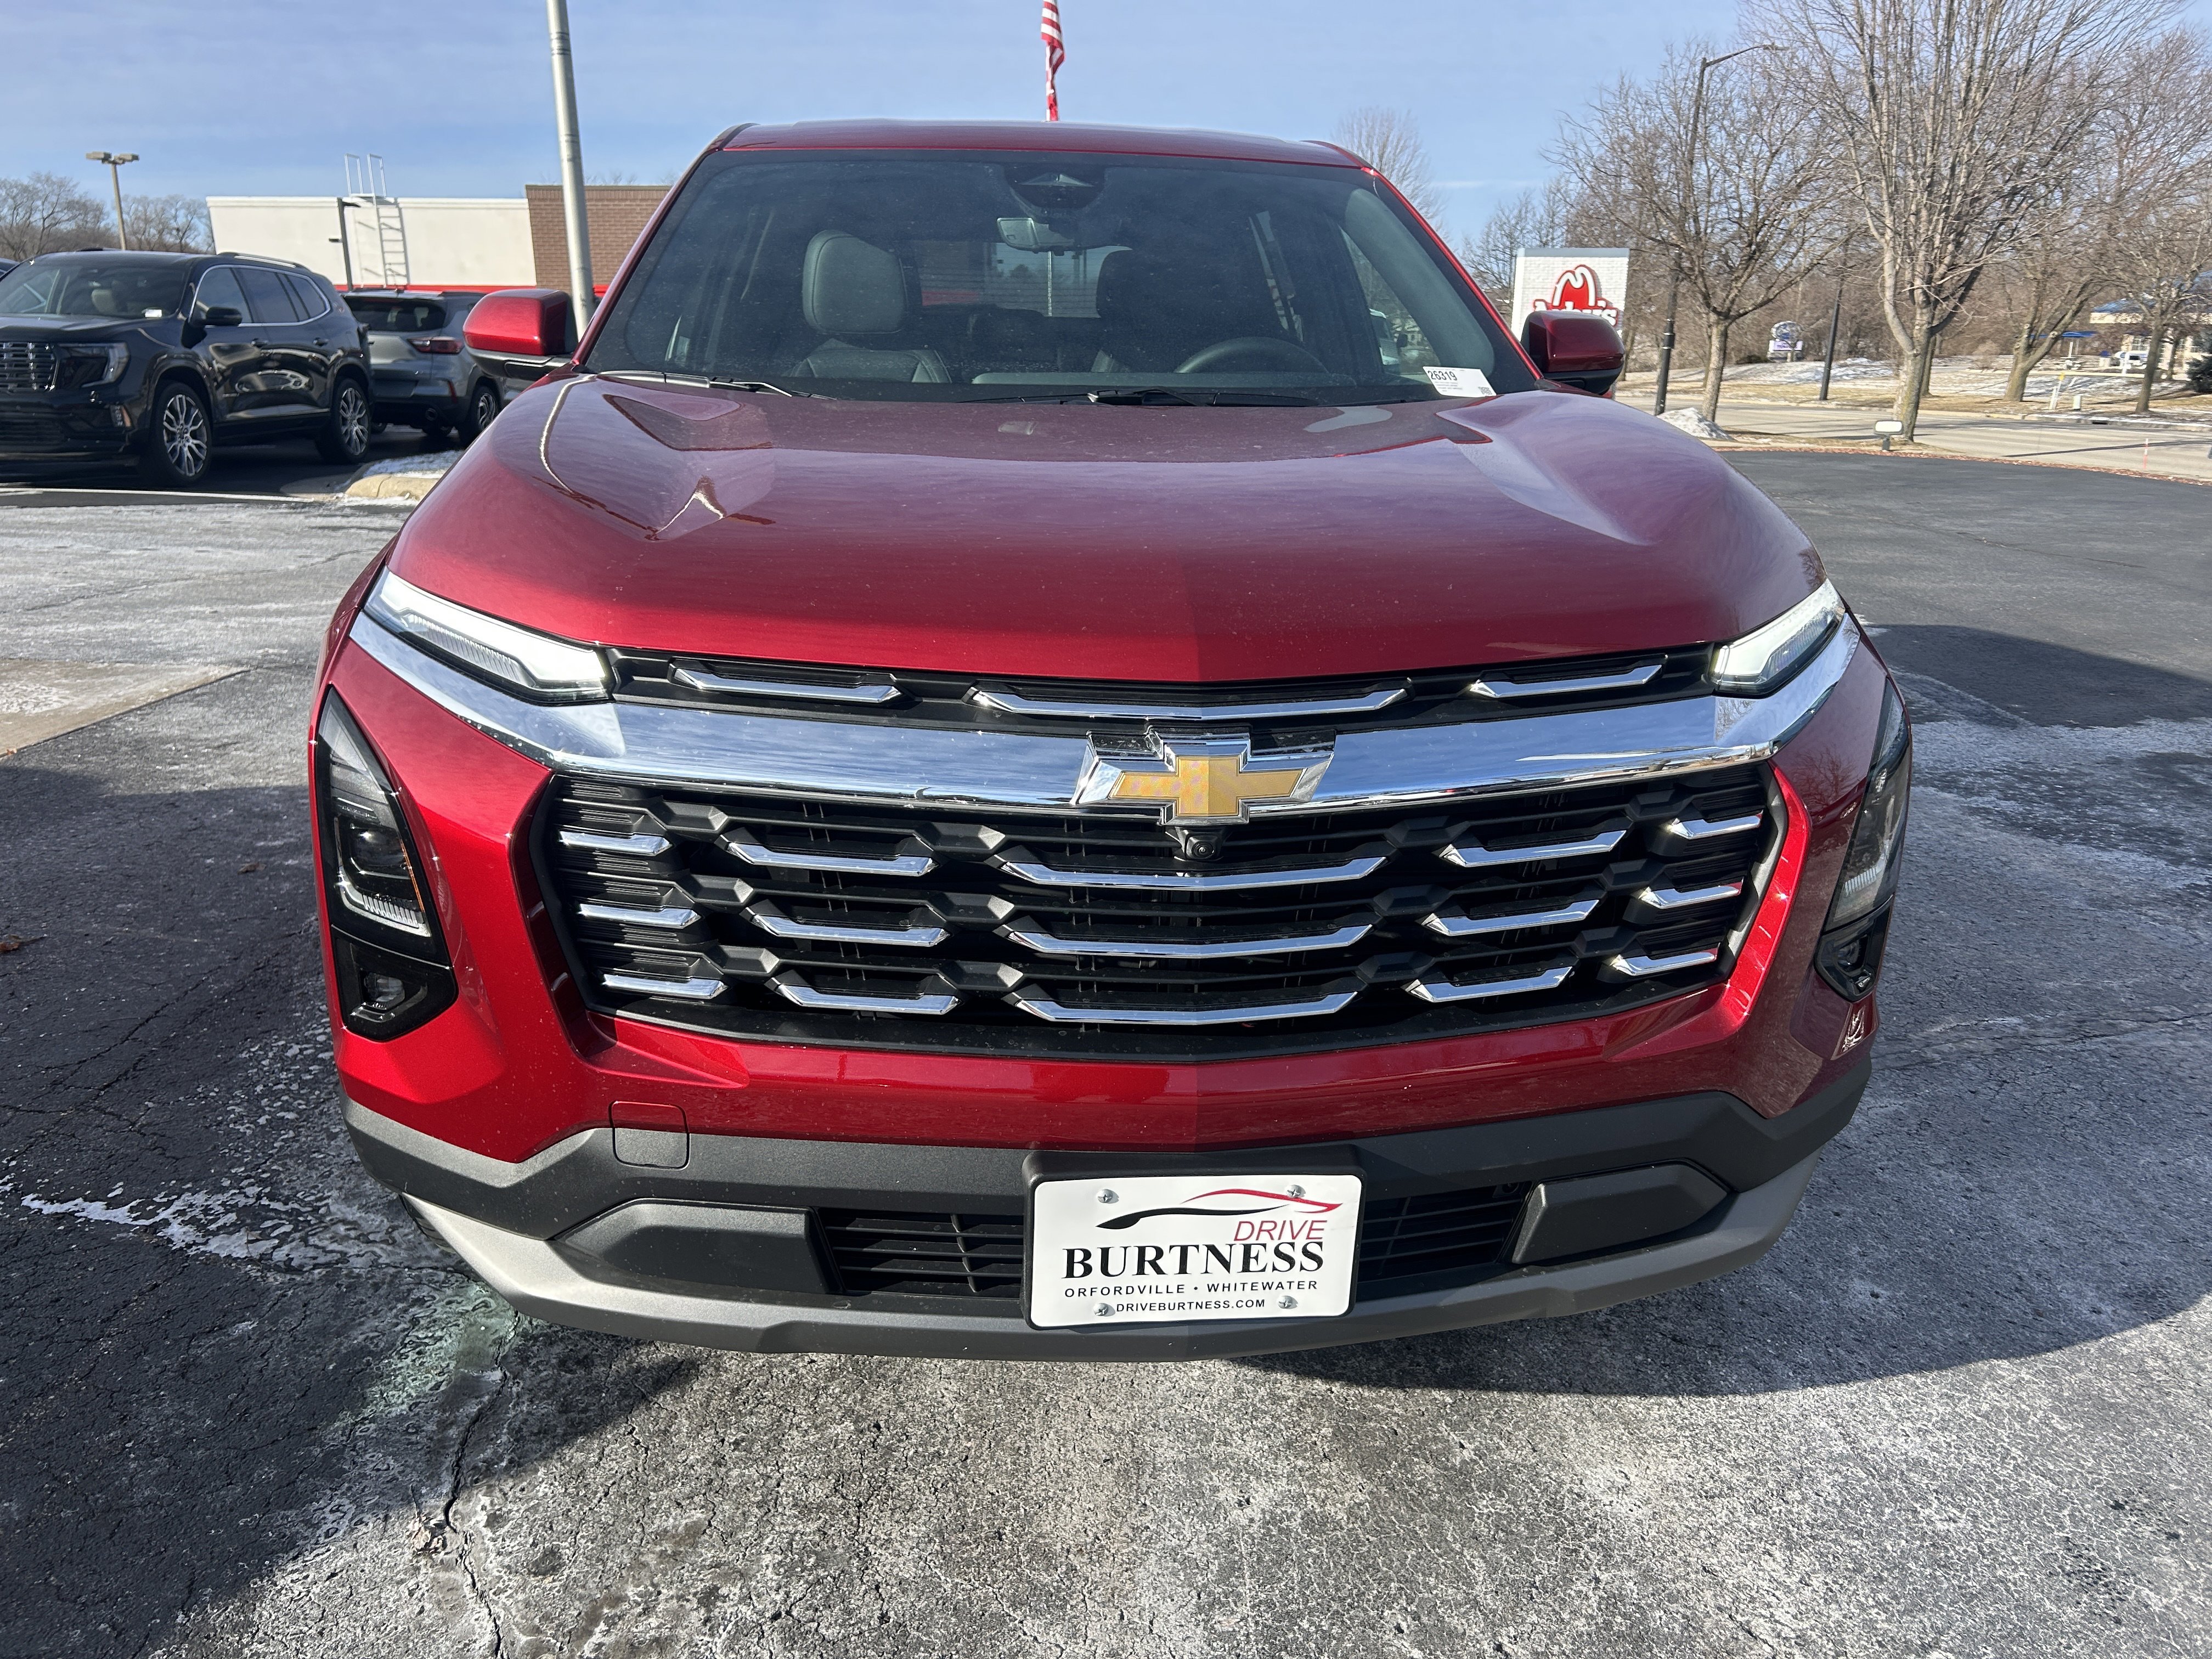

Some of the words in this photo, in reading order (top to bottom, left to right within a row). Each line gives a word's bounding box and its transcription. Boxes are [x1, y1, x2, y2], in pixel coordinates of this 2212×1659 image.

[1427, 370, 1458, 381] 26319
[1234, 1220, 1327, 1241] DRIVE
[1062, 1242, 1324, 1278] BURTNESS
[1064, 1284, 1186, 1297] ORFORDVILLE
[1207, 1280, 1318, 1293] WHITEWATER
[1116, 1299, 1265, 1312] DRIVEBURTNESS.COM
